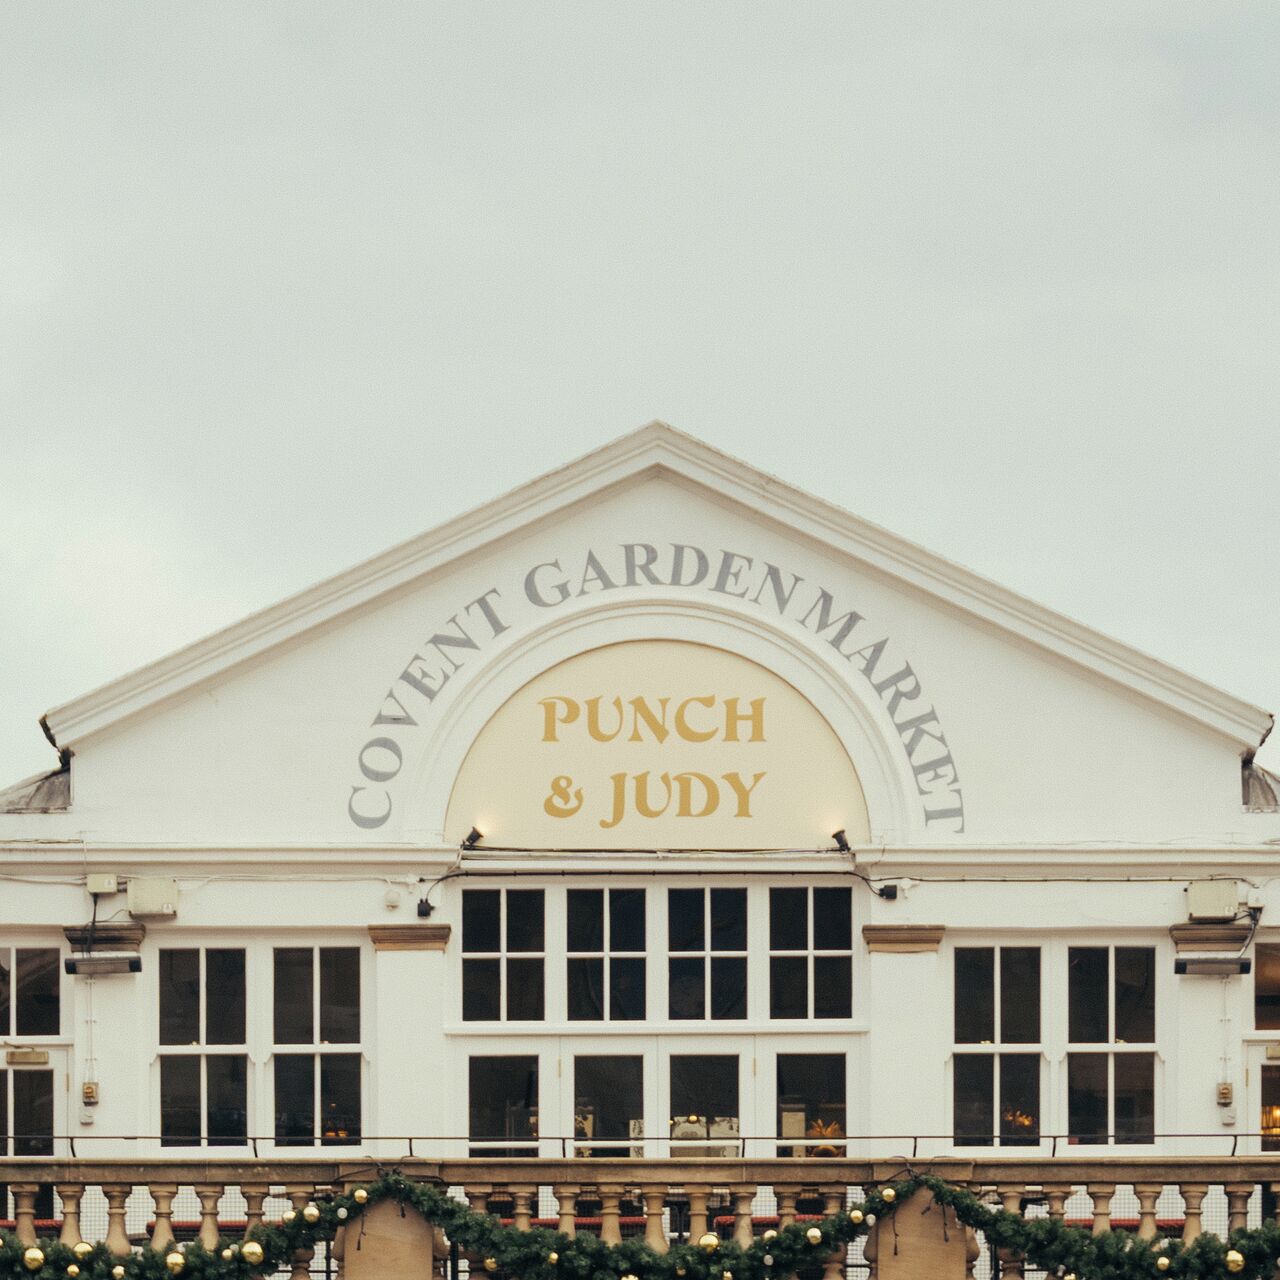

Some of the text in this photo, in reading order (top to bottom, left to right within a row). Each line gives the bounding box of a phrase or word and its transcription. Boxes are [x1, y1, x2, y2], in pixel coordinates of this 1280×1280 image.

[348, 542, 965, 834] COVENT GARDEN MARKET
[536, 694, 767, 743] PUNCH
[543, 770, 767, 829] & JUDY
